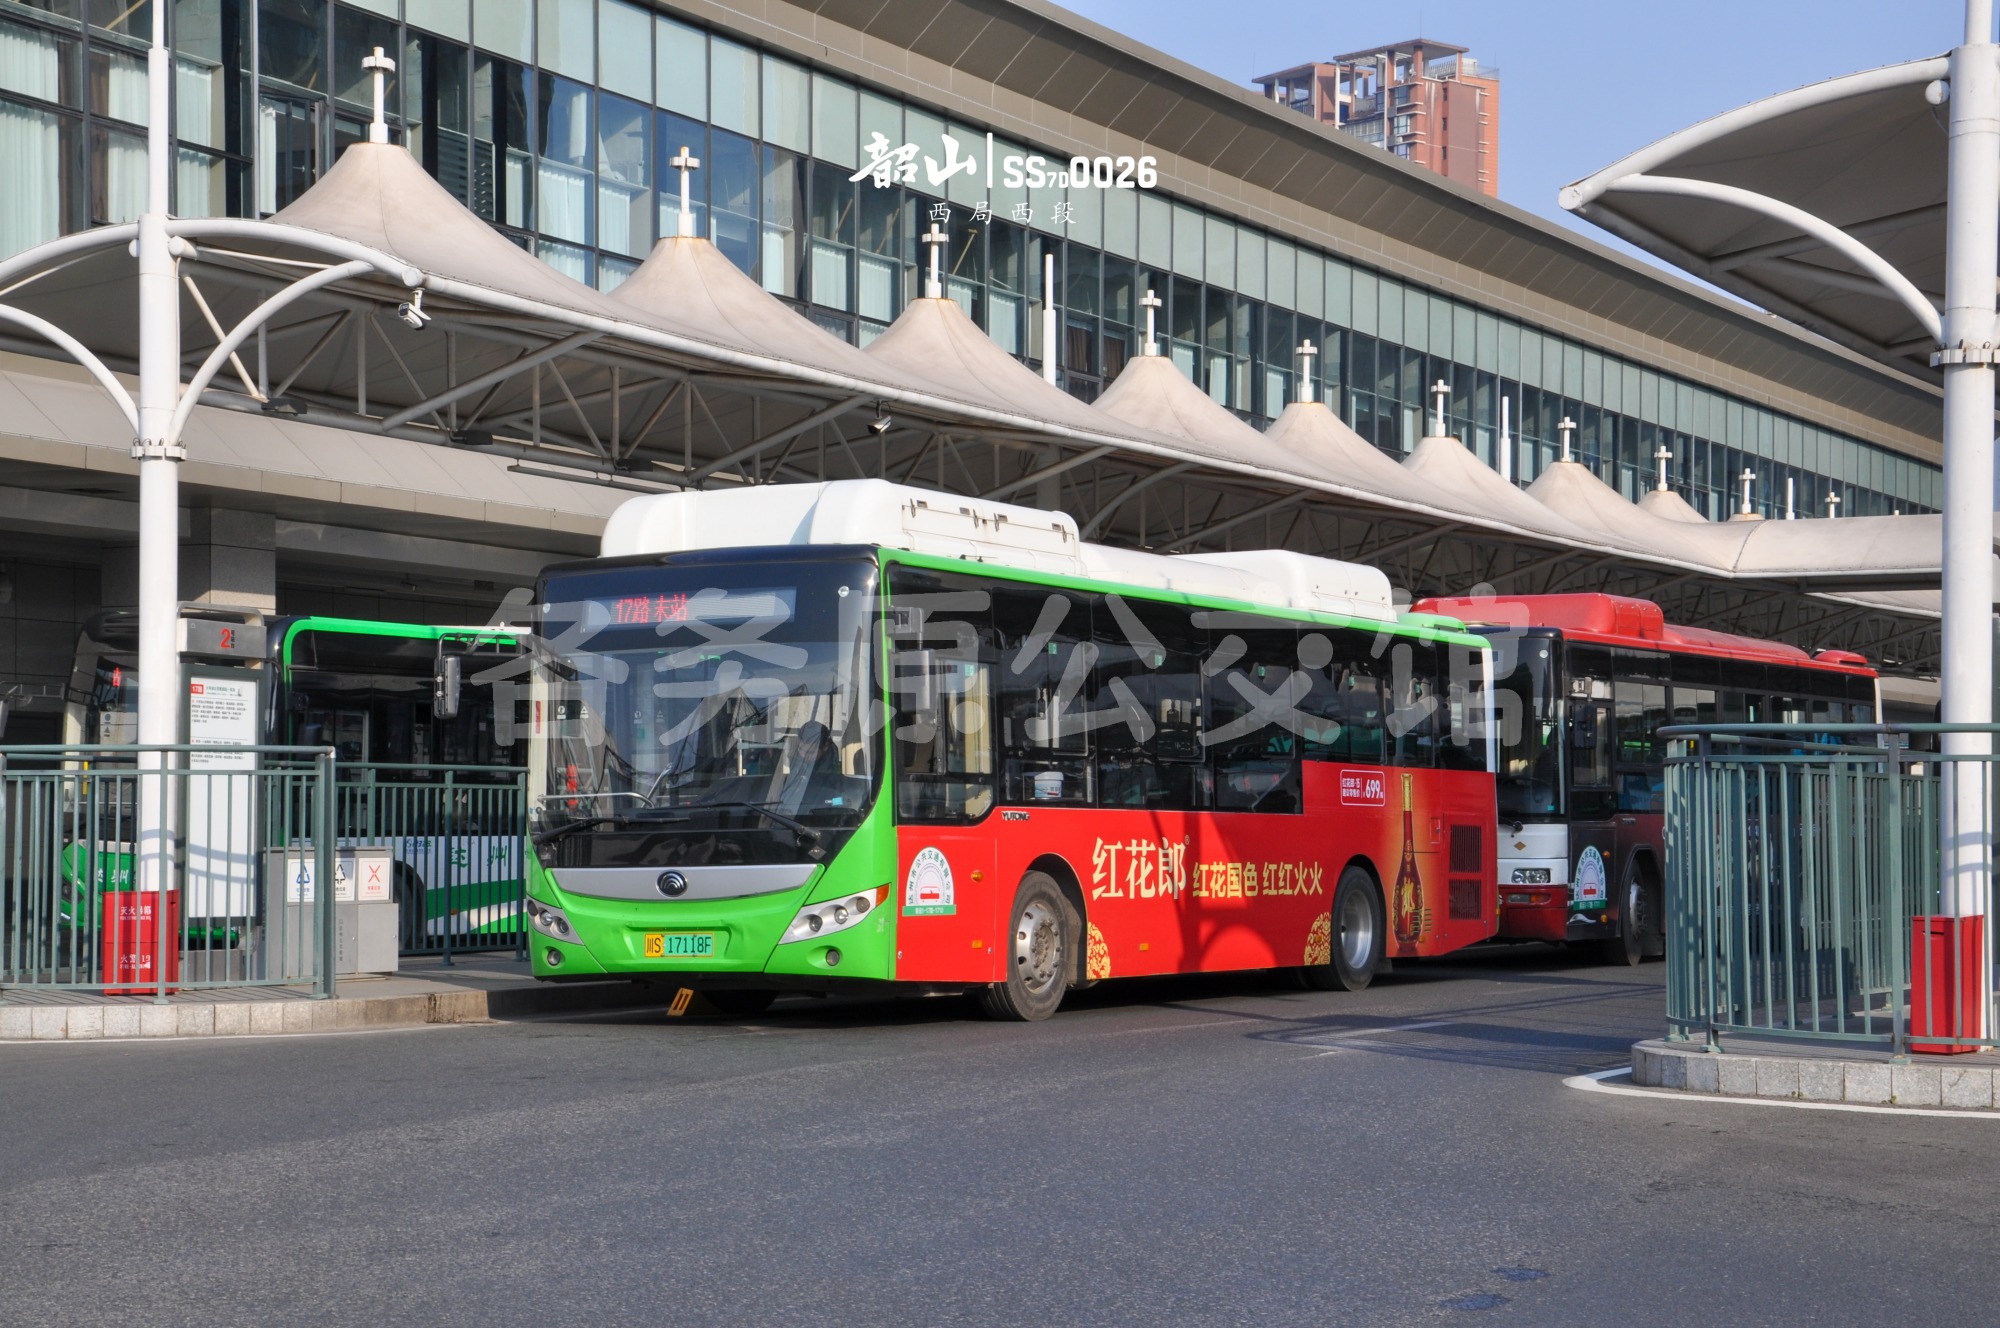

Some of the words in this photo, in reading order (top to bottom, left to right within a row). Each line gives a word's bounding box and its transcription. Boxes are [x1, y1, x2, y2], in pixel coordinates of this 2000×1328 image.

[220, 627, 231, 648] 2
[1001, 810, 1030, 821] YUTONG
[1092, 836, 1187, 901] 红花郎
[1192, 861, 1259, 898] 红花国色
[1262, 861, 1324, 896] 红红火火
